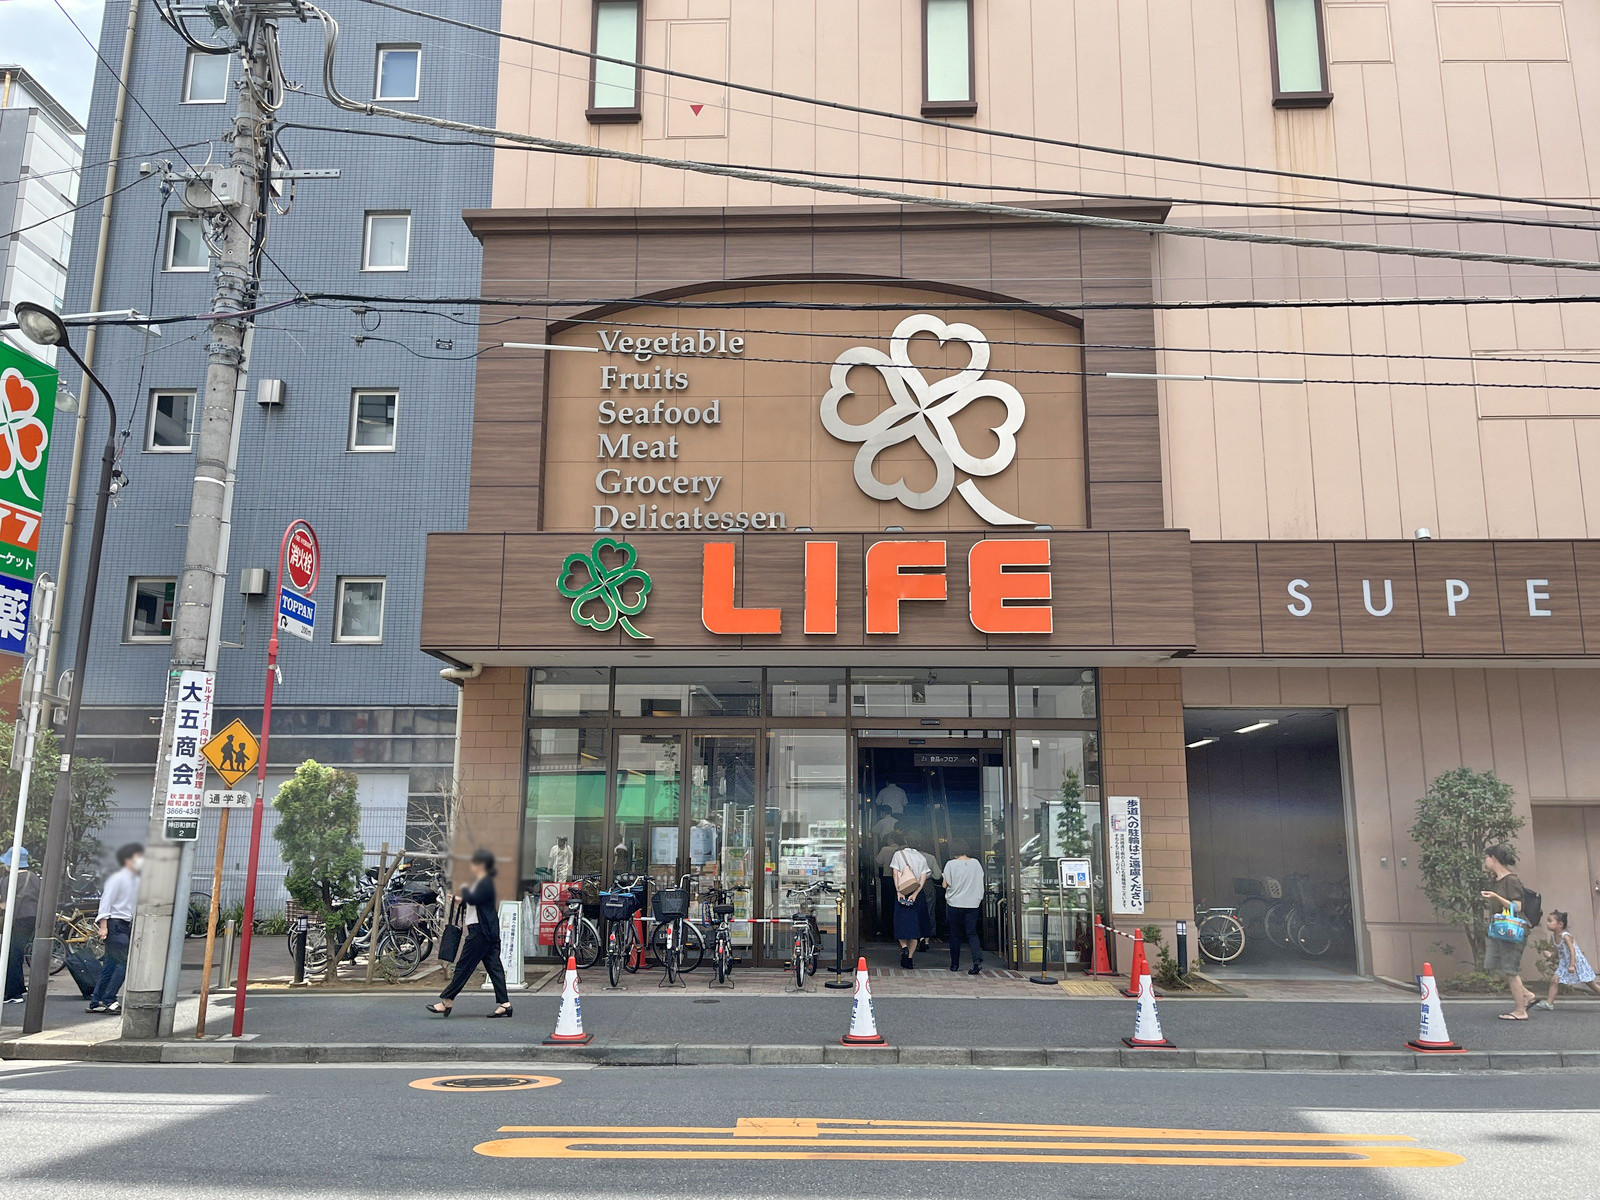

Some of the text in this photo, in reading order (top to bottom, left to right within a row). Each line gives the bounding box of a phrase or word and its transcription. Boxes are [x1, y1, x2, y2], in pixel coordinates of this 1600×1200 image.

[597, 329, 745, 362] Vegetable
[599, 365, 689, 391] Fruits
[598, 399, 722, 425] Seafood
[596, 433, 679, 459] Meat
[595, 468, 723, 502] Grocery
[592, 503, 788, 530] Delicatessen
[290, 542, 312, 575] 消火栓
[701, 538, 1054, 636] LIFE
[282, 595, 314, 620] TOPPAN
[172, 681, 203, 786] 大五商会
[194, 677, 213, 789] ビルオーナー向けンプ修理
[167, 800, 201, 808] 昭和通り口
[209, 793, 247, 805] 通学路
